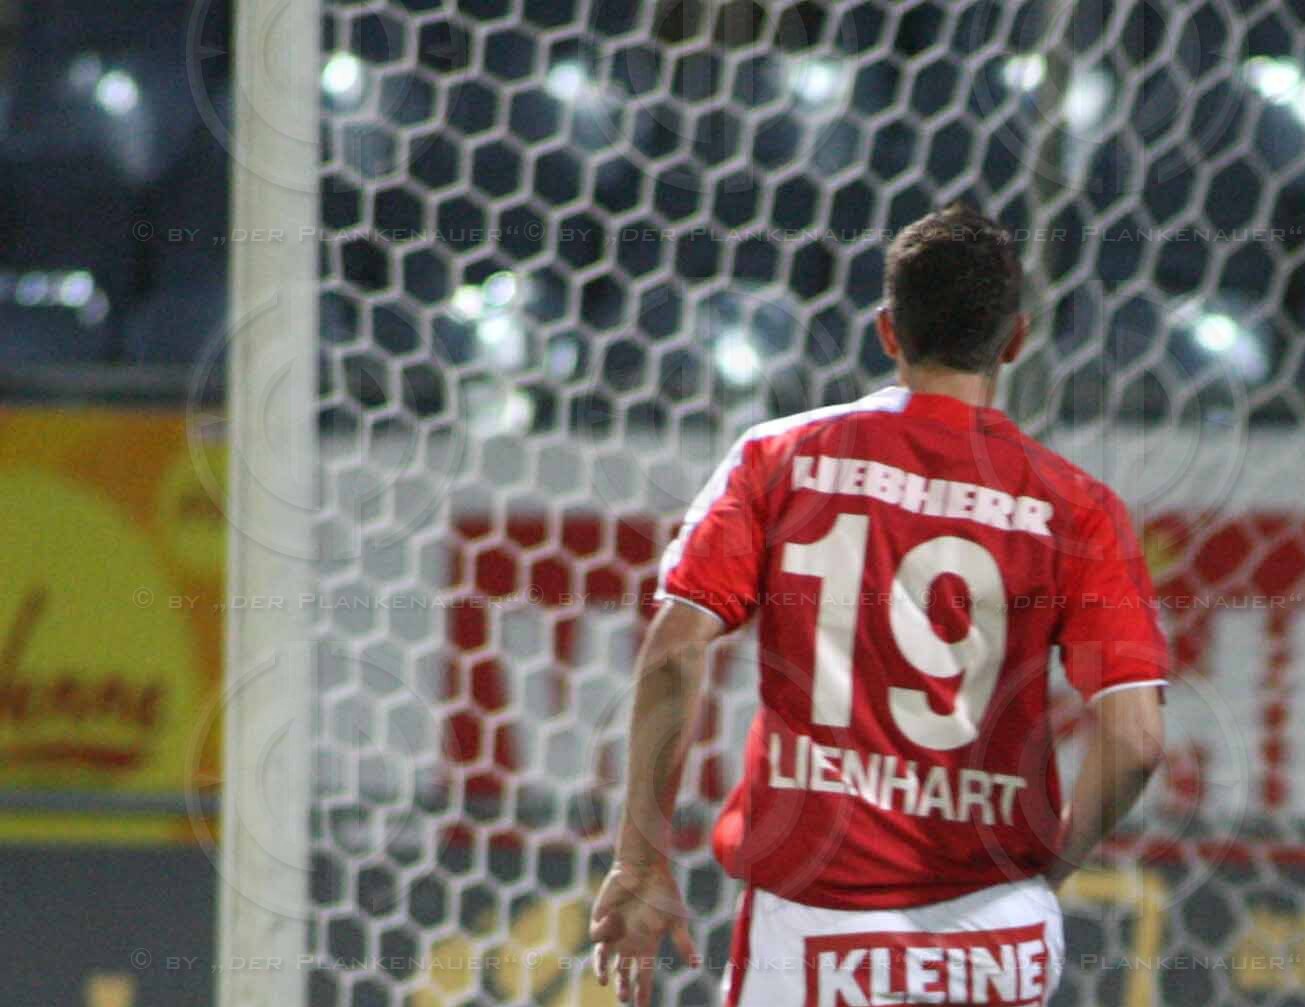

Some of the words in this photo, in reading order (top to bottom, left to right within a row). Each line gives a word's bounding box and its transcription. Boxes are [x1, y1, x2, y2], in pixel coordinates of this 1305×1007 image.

[792, 456, 1054, 536] LIEBHERR
[782, 513, 1007, 752] 19
[767, 732, 1028, 826] LIENHART
